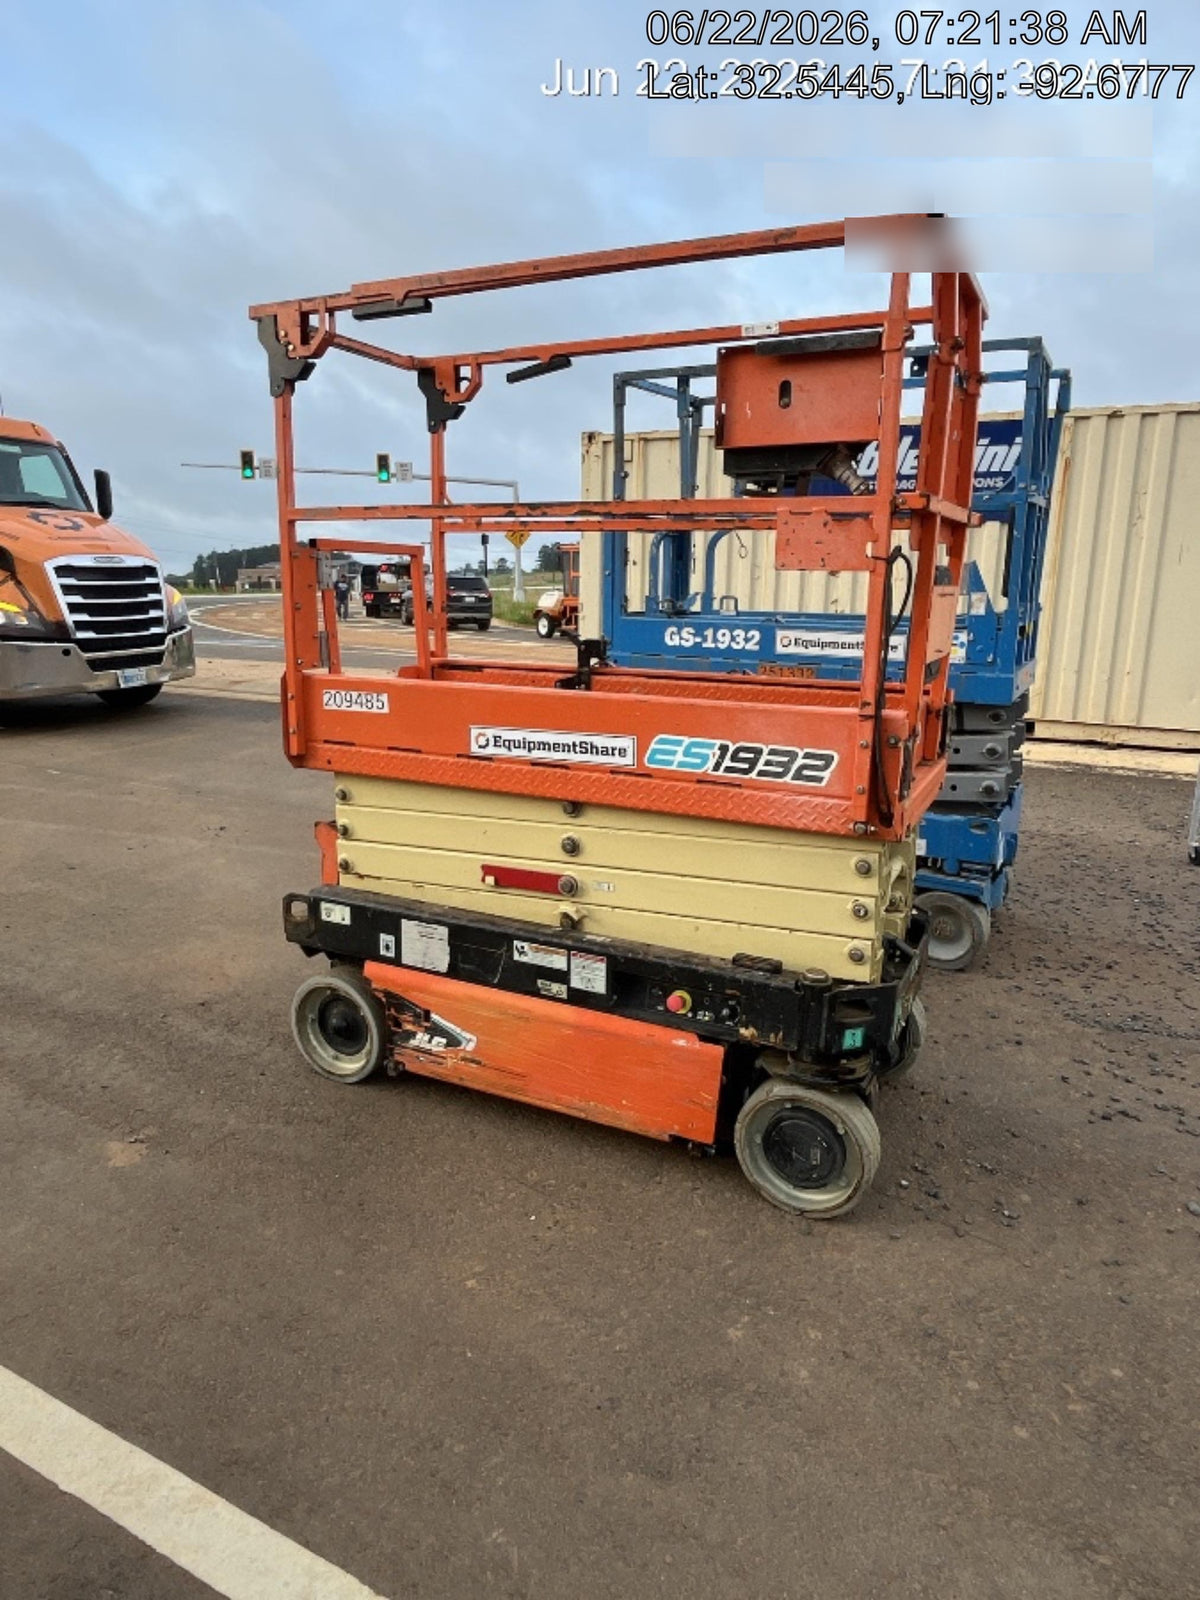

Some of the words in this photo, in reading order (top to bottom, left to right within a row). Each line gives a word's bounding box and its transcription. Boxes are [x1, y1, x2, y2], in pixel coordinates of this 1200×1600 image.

[664, 626, 761, 651] GS-1932
[323, 690, 386, 710] 209485
[492, 735, 629, 758] EquipmentShare
[645, 736, 836, 785] ES1932
